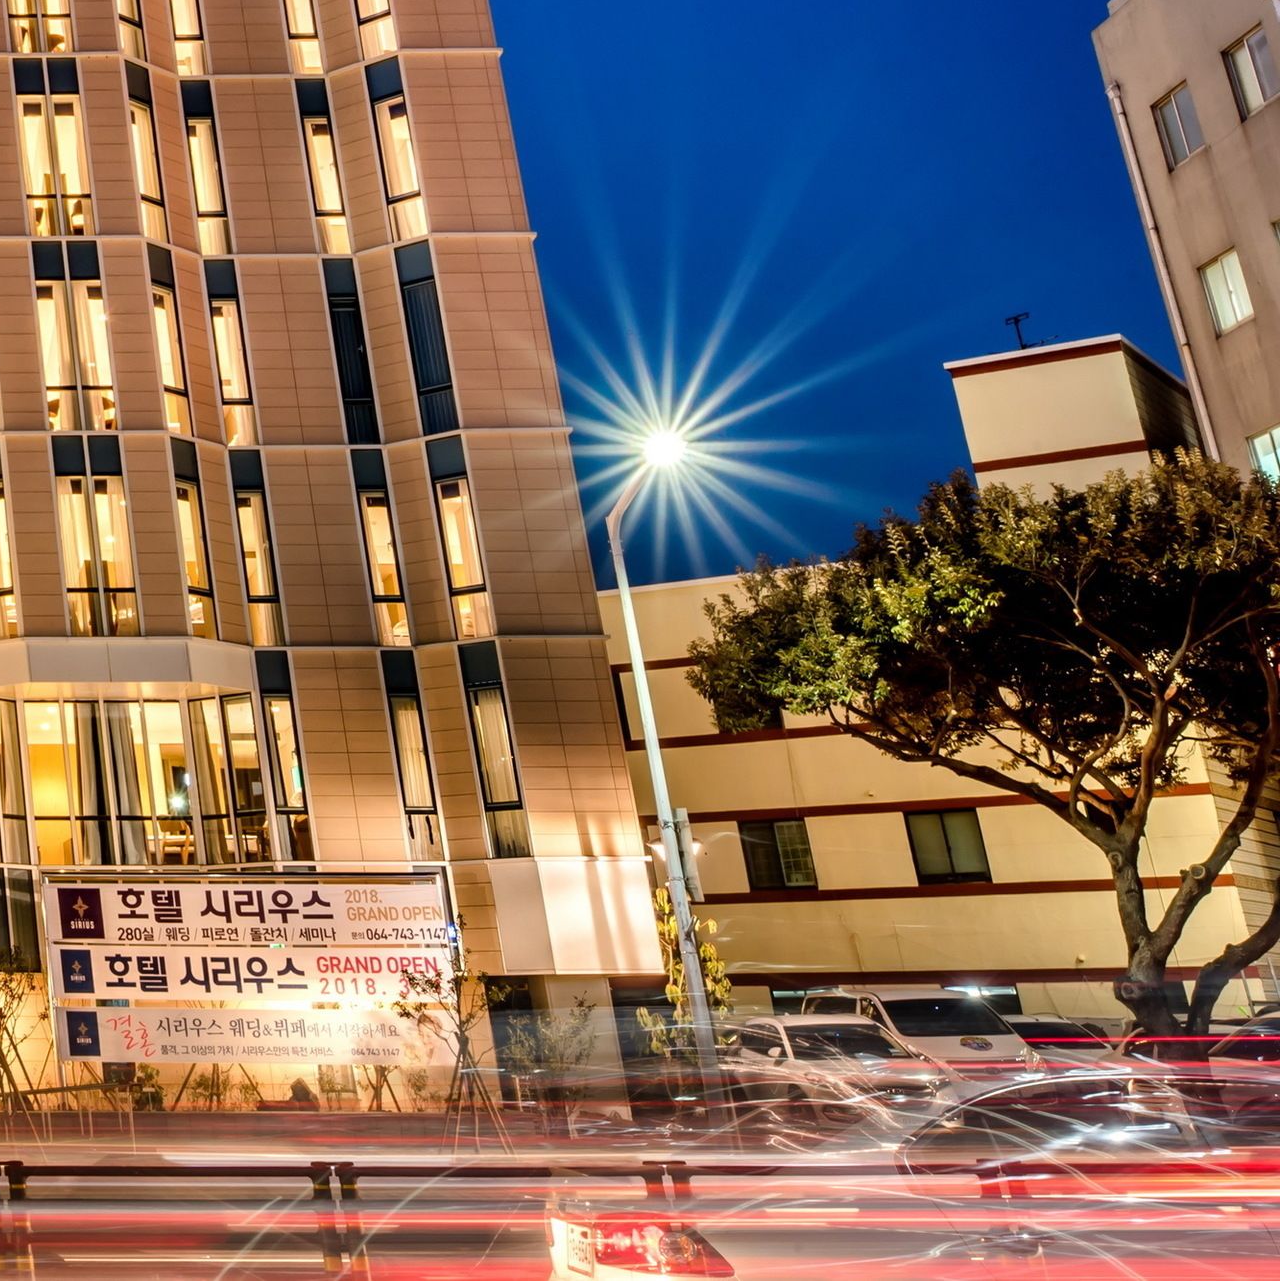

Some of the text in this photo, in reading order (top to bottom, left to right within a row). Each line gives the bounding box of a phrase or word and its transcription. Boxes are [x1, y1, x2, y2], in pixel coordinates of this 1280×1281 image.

[344, 889, 383, 904] 2018.
[117, 888, 334, 924] 호텔 시리우스
[347, 906, 443, 922] GRAND OPEN
[70, 920, 95, 930] SIRIUS
[117, 927, 337, 942] 280실 웨딩 피로연 돌잔치 세미나
[366, 927, 447, 941] 064-743-1147
[317, 956, 439, 974] GRAND OPEN
[105, 954, 309, 993] 호텔 시리우스
[156, 1017, 224, 1038] 시리우스
[337, 1022, 401, 1039] 시작하세요
[181, 1045, 190, 1055] 그
[191, 1045, 216, 1056] 이상의
[217, 1045, 234, 1056] 가치
[241, 1045, 290, 1057] 시리우스만의
[309, 1046, 334, 1057] 서비스
